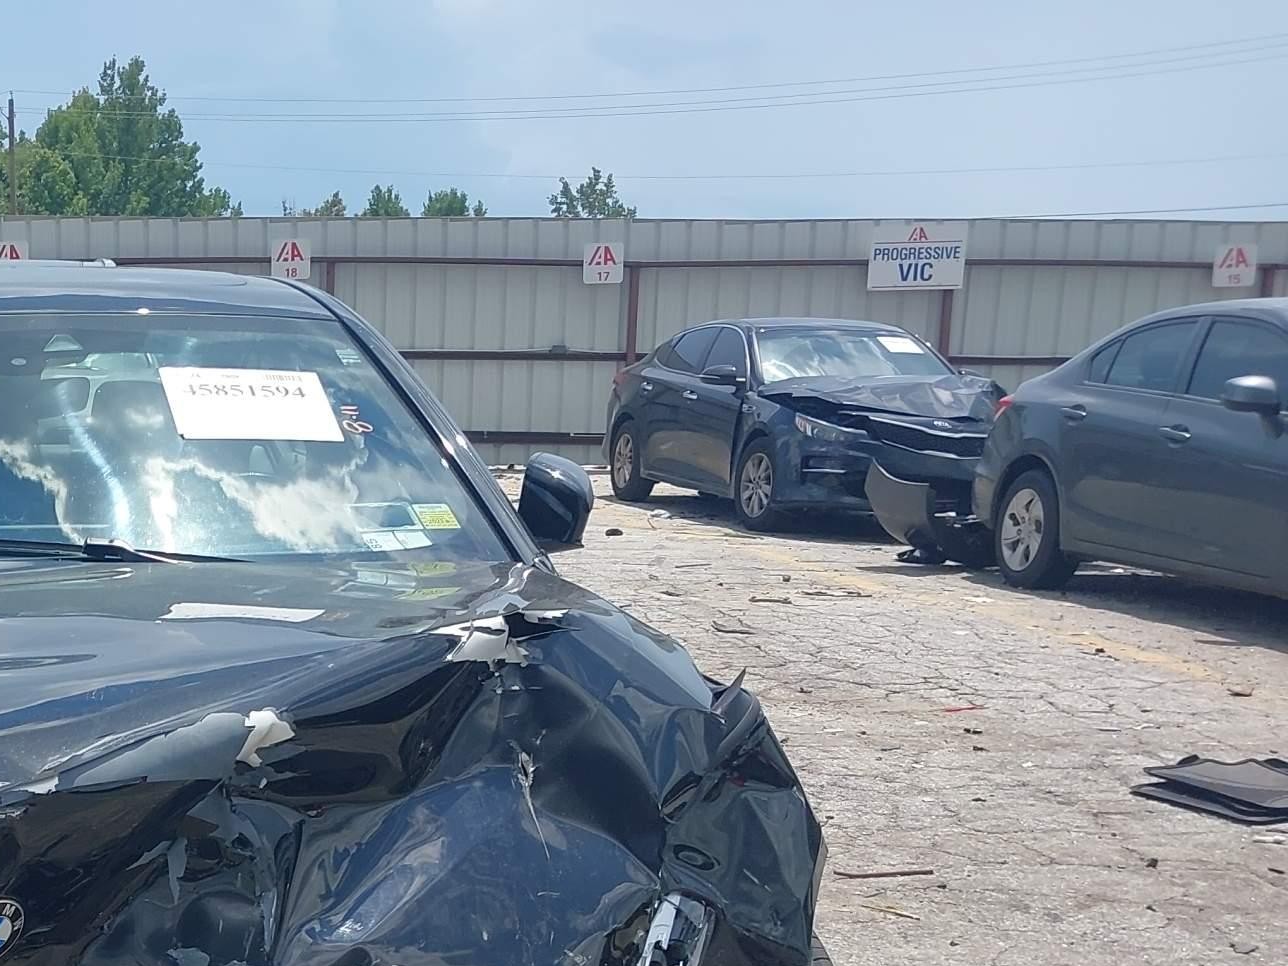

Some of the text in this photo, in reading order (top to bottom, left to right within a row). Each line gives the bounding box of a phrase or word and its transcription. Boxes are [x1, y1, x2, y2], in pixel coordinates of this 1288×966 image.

[874, 246, 961, 260] PROGRESSIVE
[285, 268, 297, 277] 18
[598, 272, 610, 281] 17
[899, 263, 933, 281] VIC
[184, 384, 306, 398] 45851594
